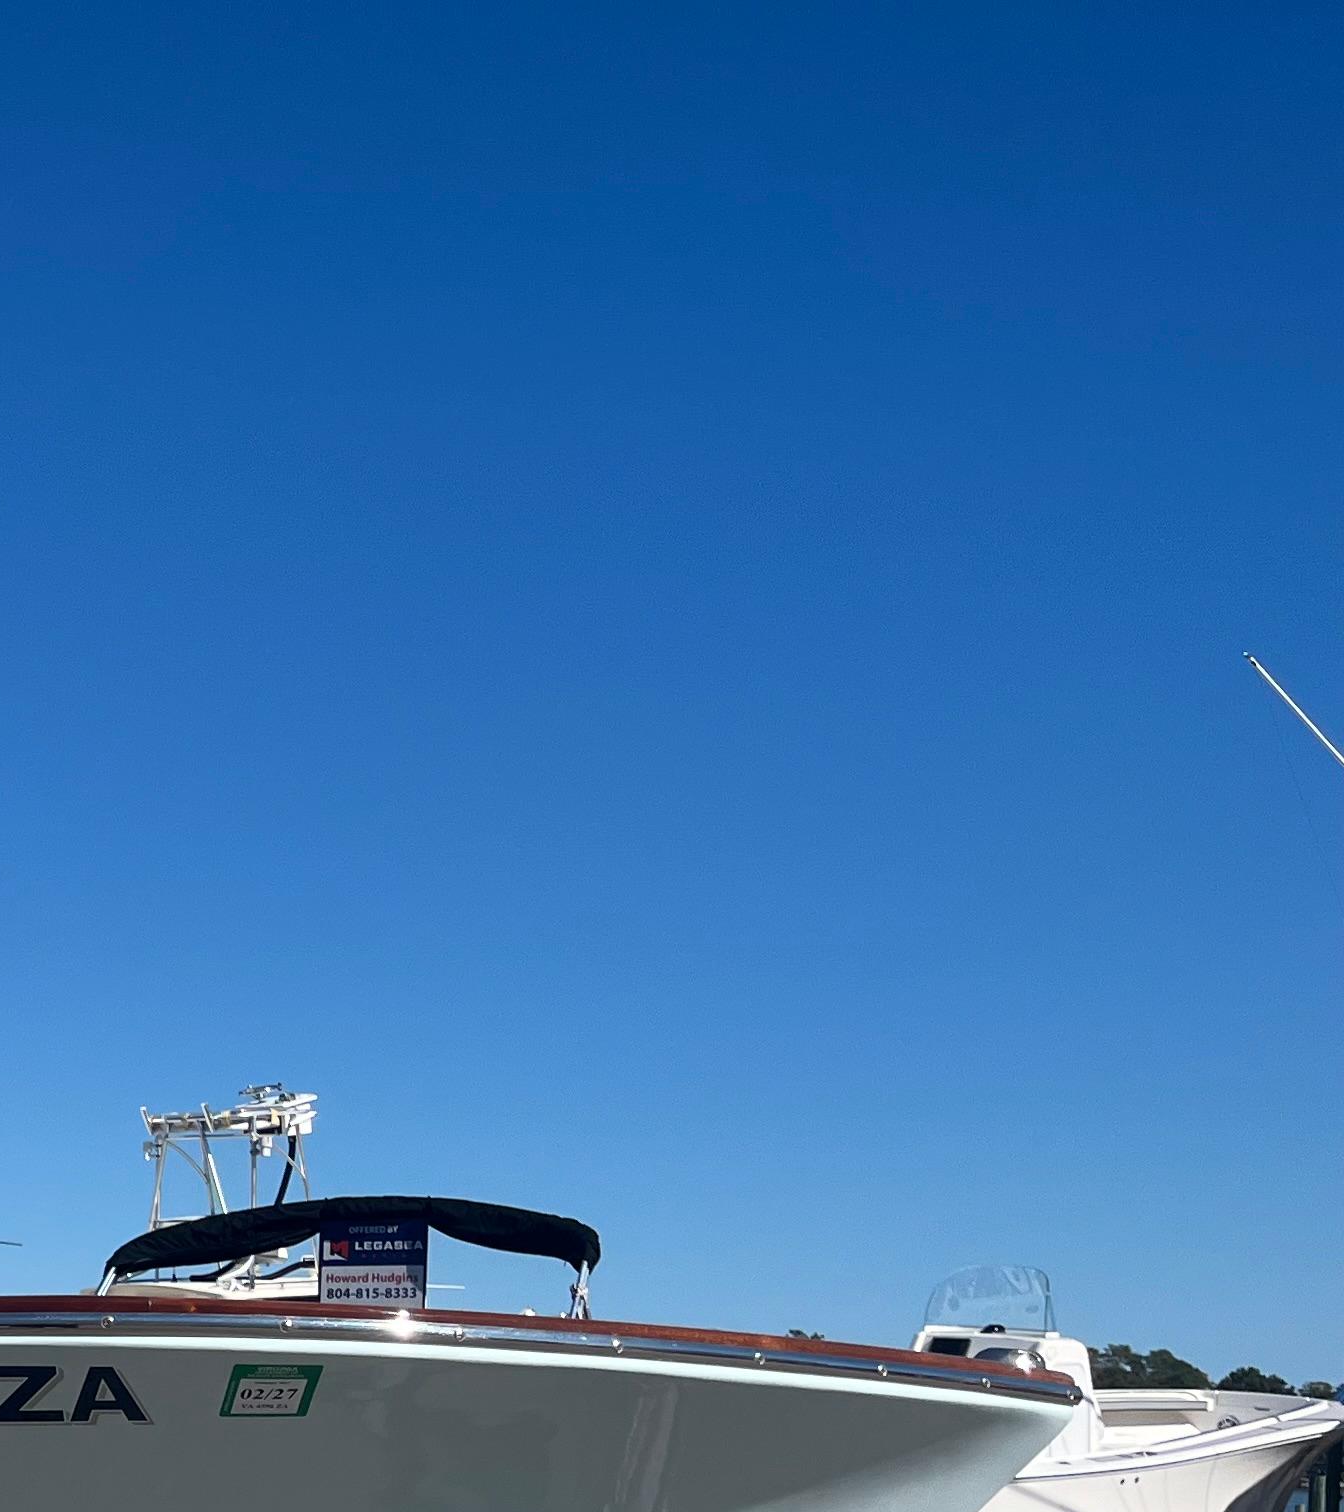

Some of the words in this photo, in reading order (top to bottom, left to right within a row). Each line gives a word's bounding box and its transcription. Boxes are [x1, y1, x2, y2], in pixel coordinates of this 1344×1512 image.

[349, 1225, 386, 1234] OFFERED
[387, 1225, 399, 1234] BY
[354, 1240, 424, 1251] LEGASEA
[326, 1273, 369, 1284] Howard
[372, 1273, 418, 1286] Hudgins
[326, 1287, 417, 1300] 804-815-8333
[239, 1388, 299, 1400] 02/27
